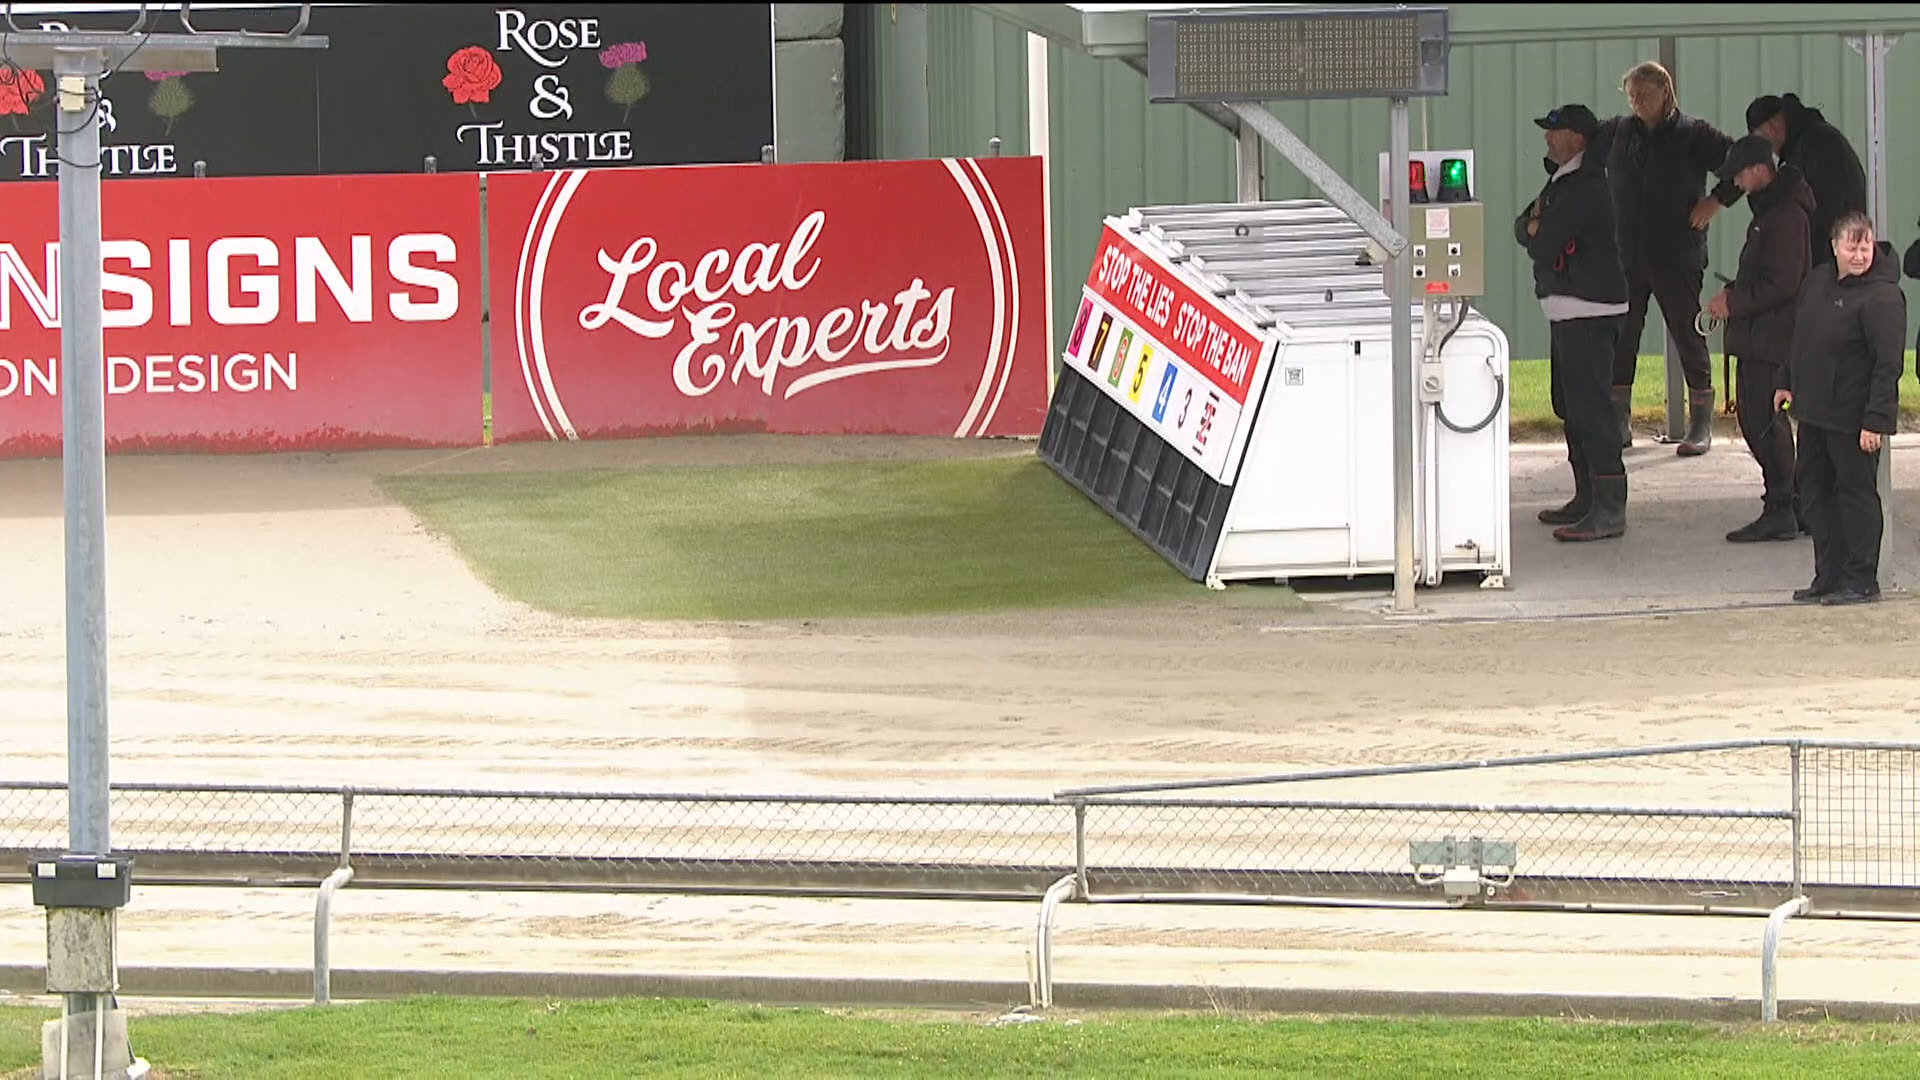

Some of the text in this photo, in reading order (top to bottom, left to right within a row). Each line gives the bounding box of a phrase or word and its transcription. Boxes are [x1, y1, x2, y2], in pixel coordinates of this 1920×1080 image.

[496, 9, 601, 67] ROSE
[530, 74, 573, 120] &
[0, 133, 177, 177] THTLE
[457, 120, 633, 164] THISTLE
[578, 210, 826, 338] Local
[672, 277, 956, 400] Experts
[1099, 245, 1252, 387] STOP THE LIES STOP THE BAN
[106, 352, 298, 395] DESIGN
[1074, 308, 1088, 347] 8
[1093, 322, 1109, 361] 7
[1133, 353, 1148, 393] 5
[1159, 373, 1173, 414] 4
[1178, 388, 1193, 429] 3
